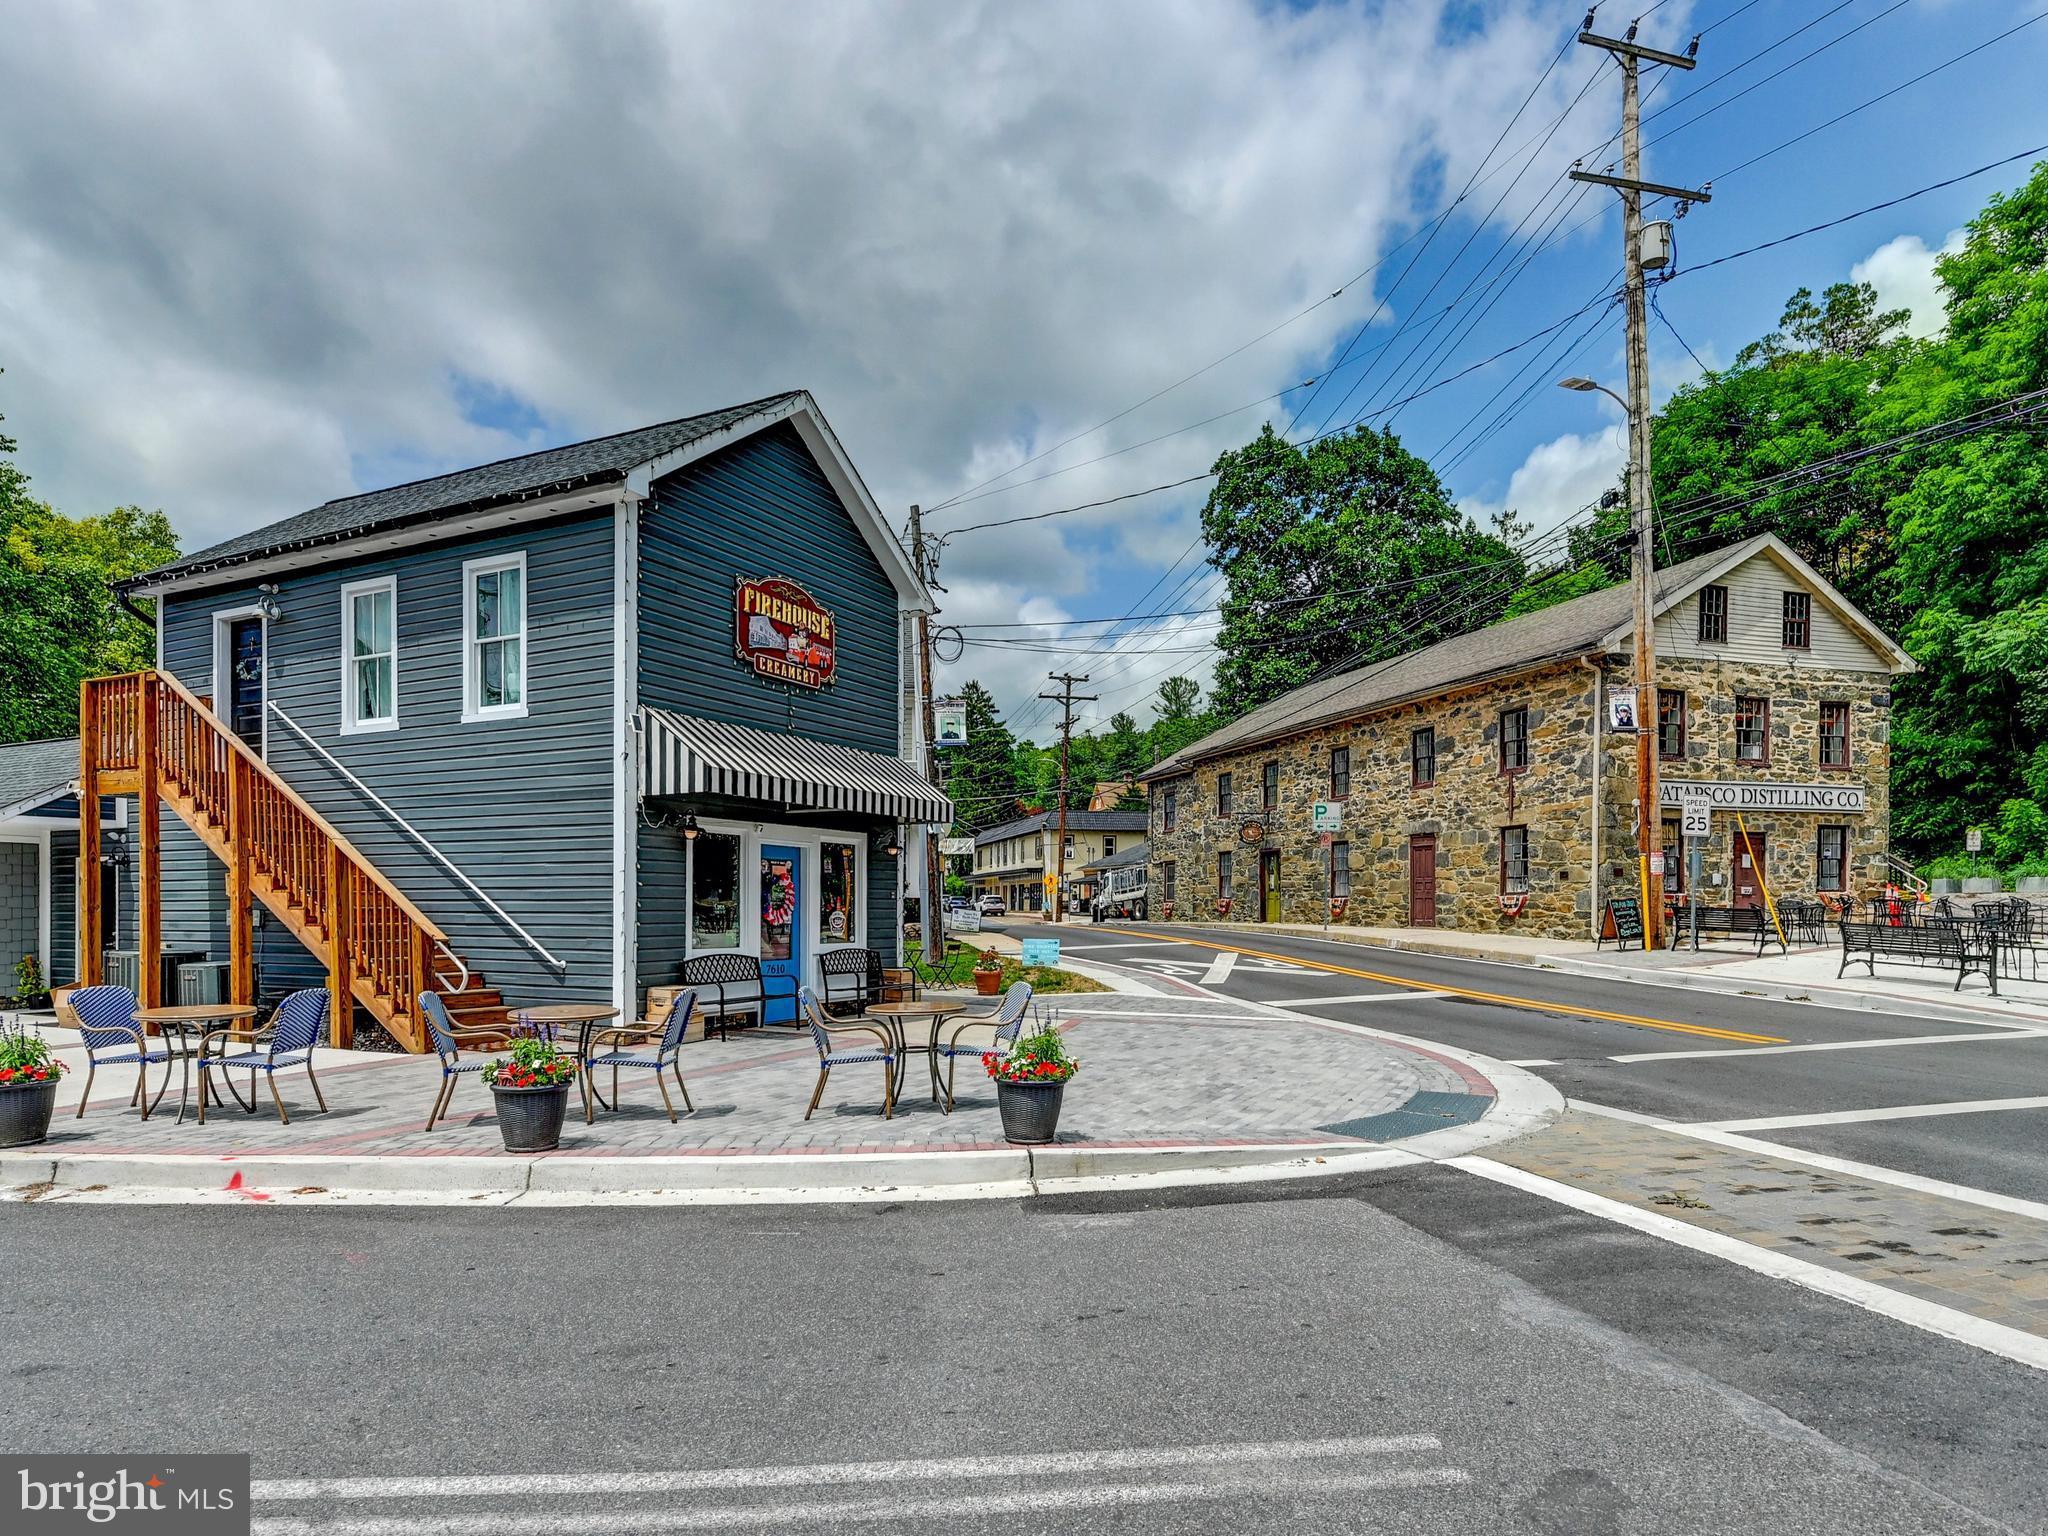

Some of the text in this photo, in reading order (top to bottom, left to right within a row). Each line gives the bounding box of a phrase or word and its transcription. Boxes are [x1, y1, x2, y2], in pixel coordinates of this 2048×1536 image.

[743, 586, 830, 640] FIREHOUSE
[759, 656, 816, 685] CREAMERY
[1660, 785, 1861, 807] ATAPSCO DISTILLING CO.
[1685, 799, 1708, 807] SPEED
[1688, 807, 1705, 815] LIMIT
[1685, 816, 1707, 831] 25
[766, 964, 785, 974] 7610
